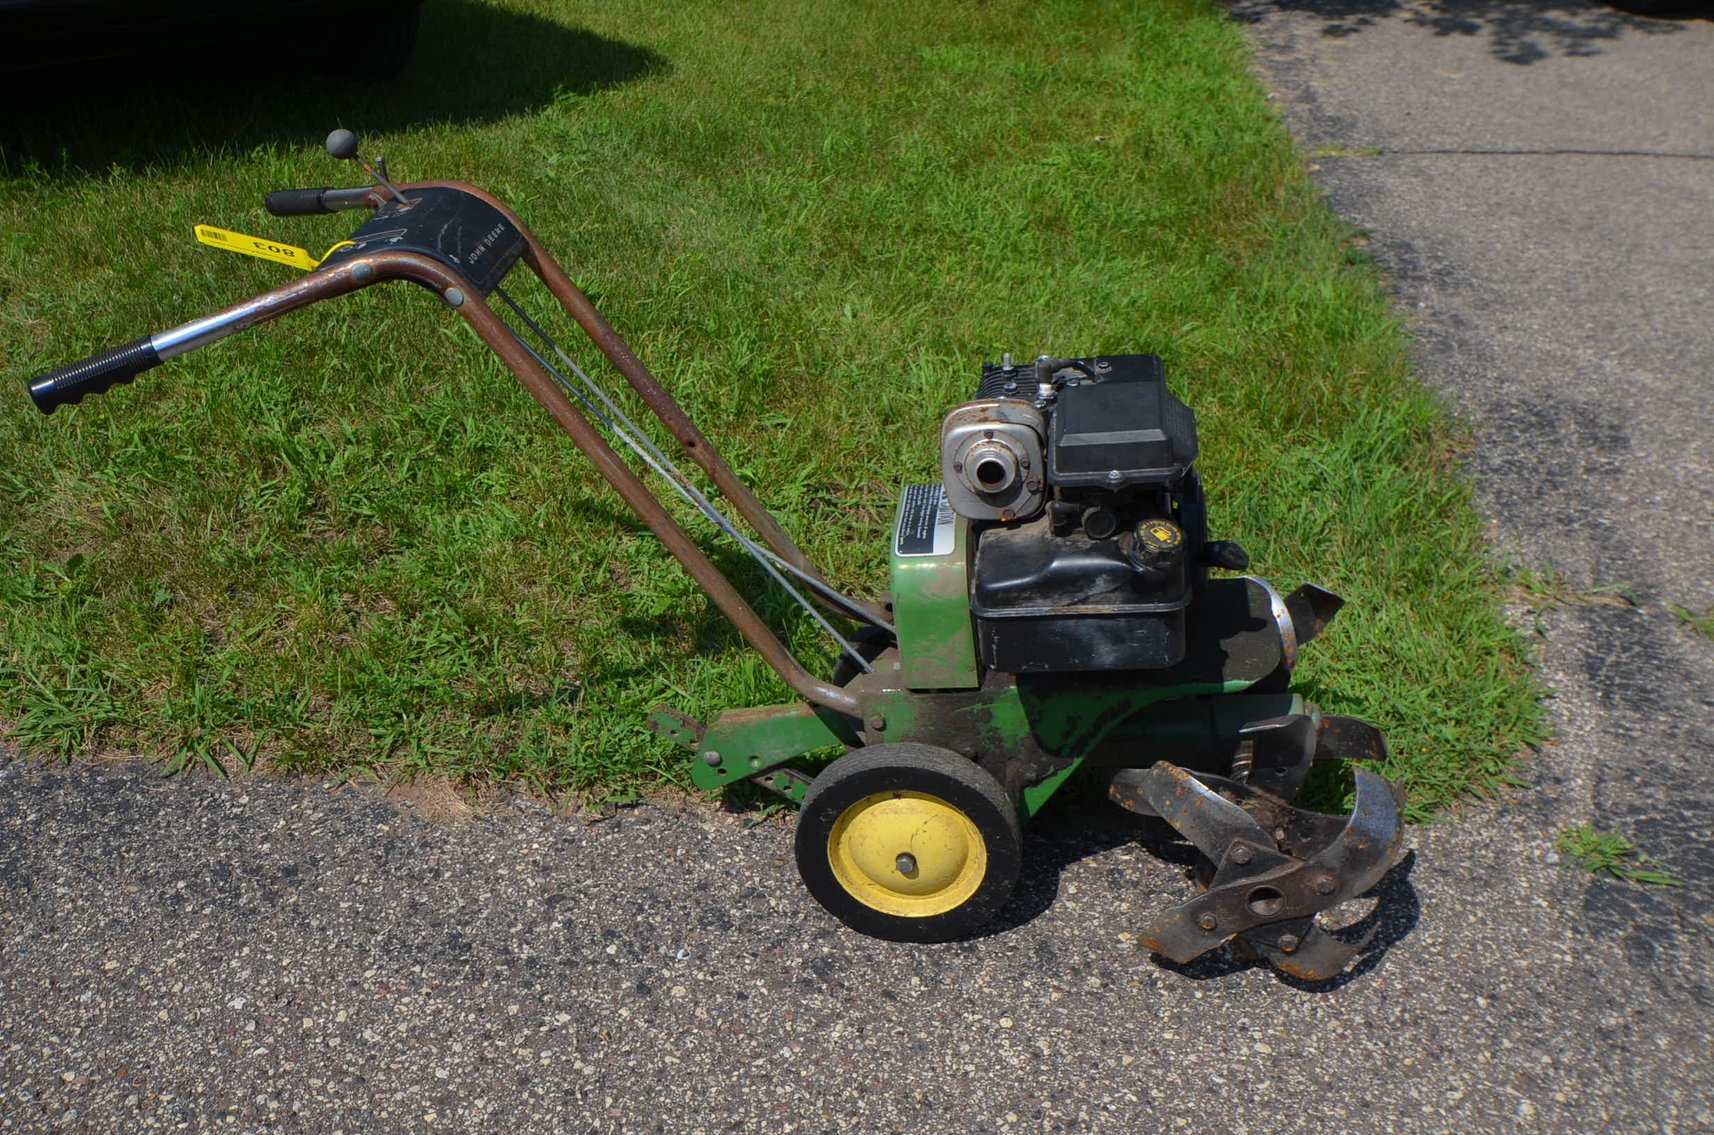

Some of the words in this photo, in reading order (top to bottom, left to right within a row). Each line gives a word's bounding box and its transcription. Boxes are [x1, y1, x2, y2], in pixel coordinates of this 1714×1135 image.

[253, 241, 295, 257] 803
[468, 244, 486, 264] JOHN
[484, 223, 505, 247] DEERE
